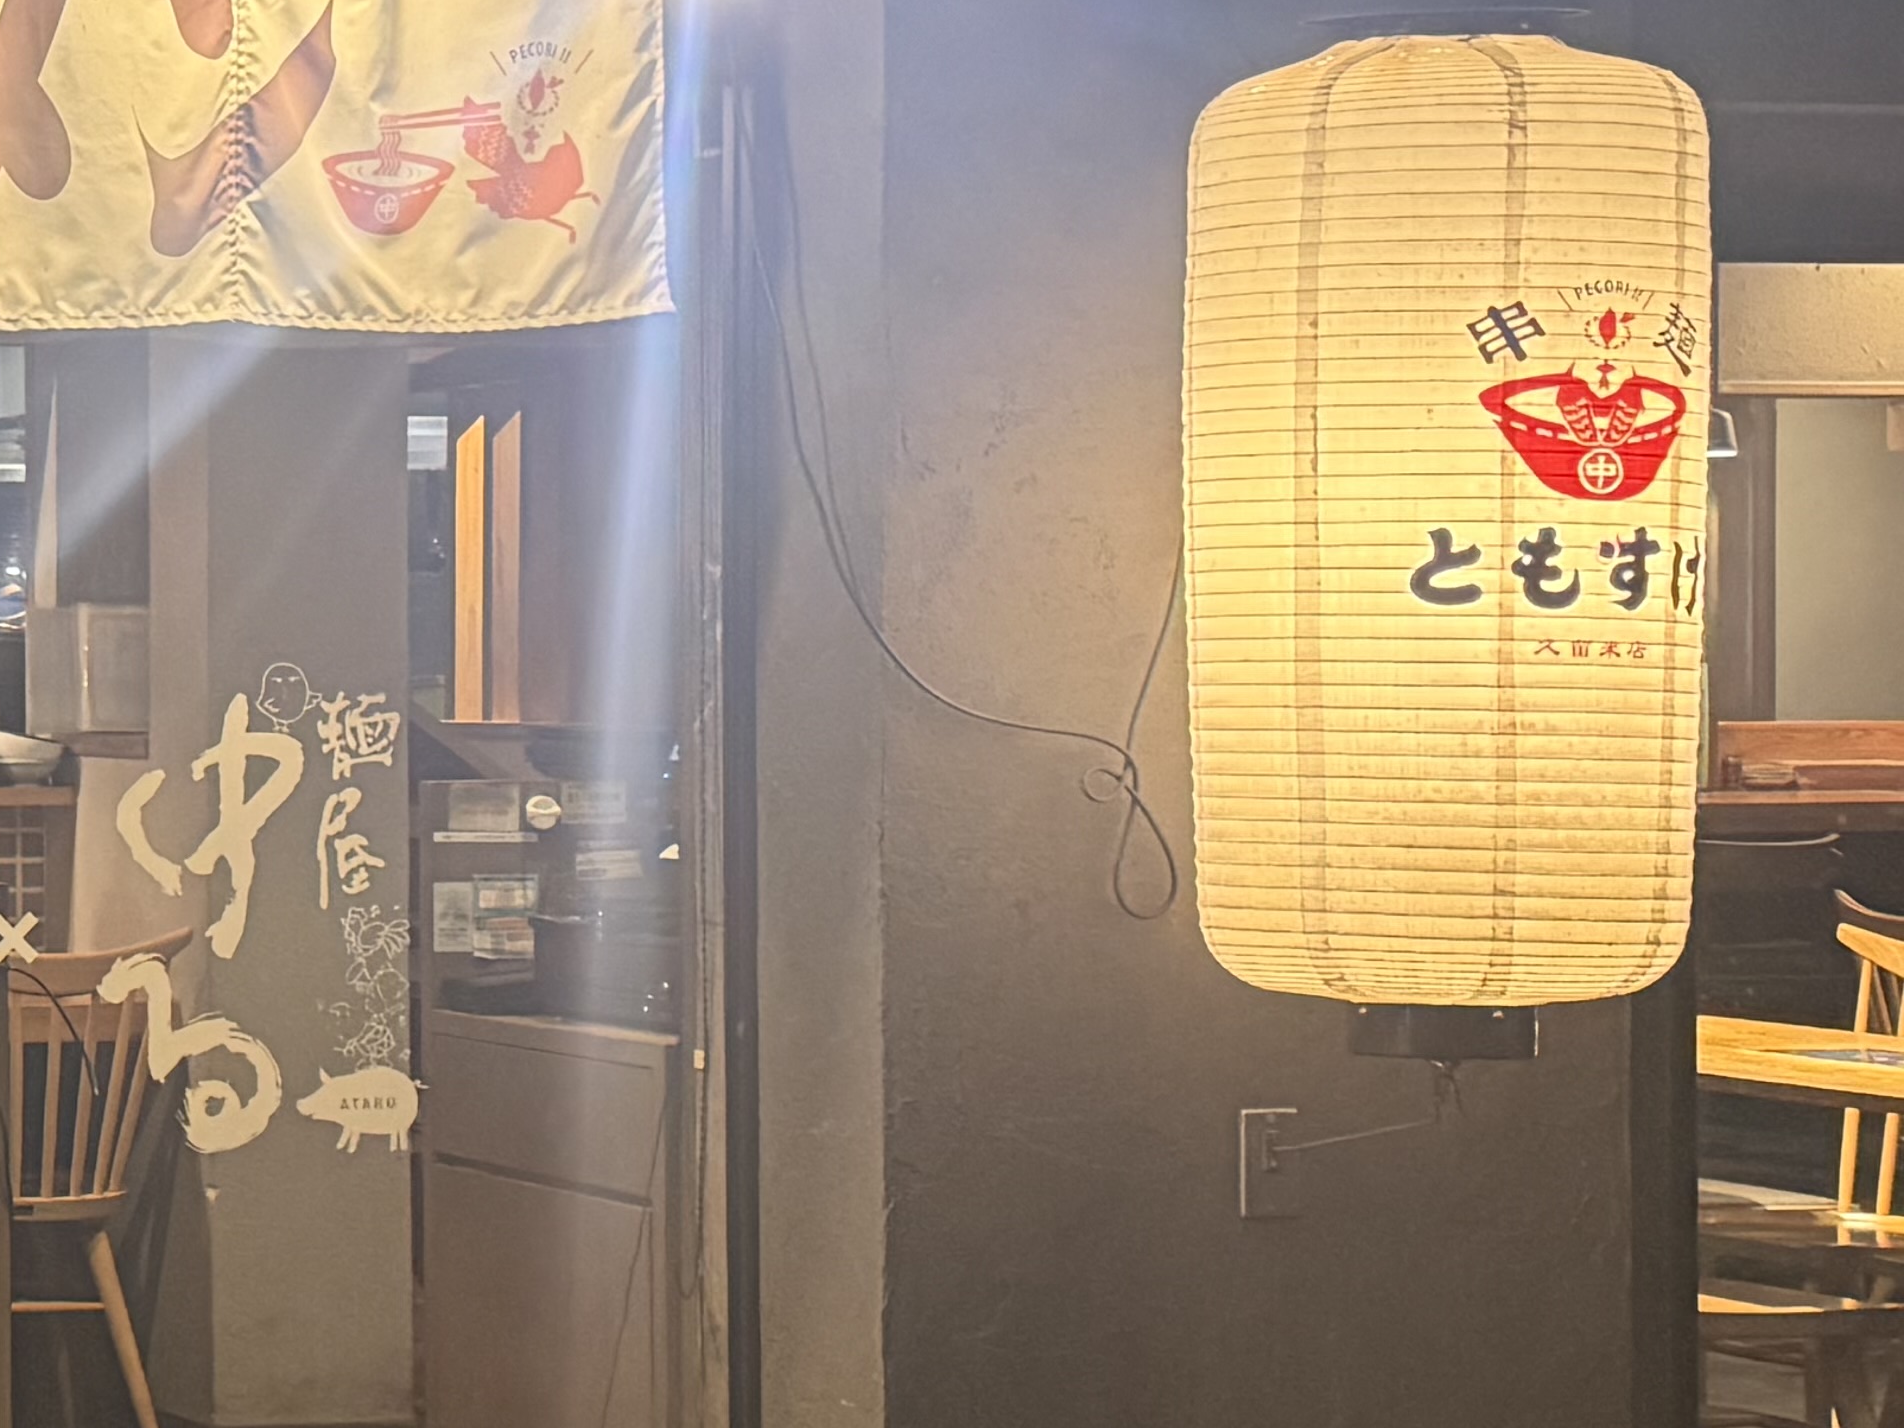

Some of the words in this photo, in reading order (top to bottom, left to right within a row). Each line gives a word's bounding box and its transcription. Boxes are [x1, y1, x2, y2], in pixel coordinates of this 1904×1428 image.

[1465, 300, 1546, 365] 串
[1409, 526, 1701, 617] ともすけ
